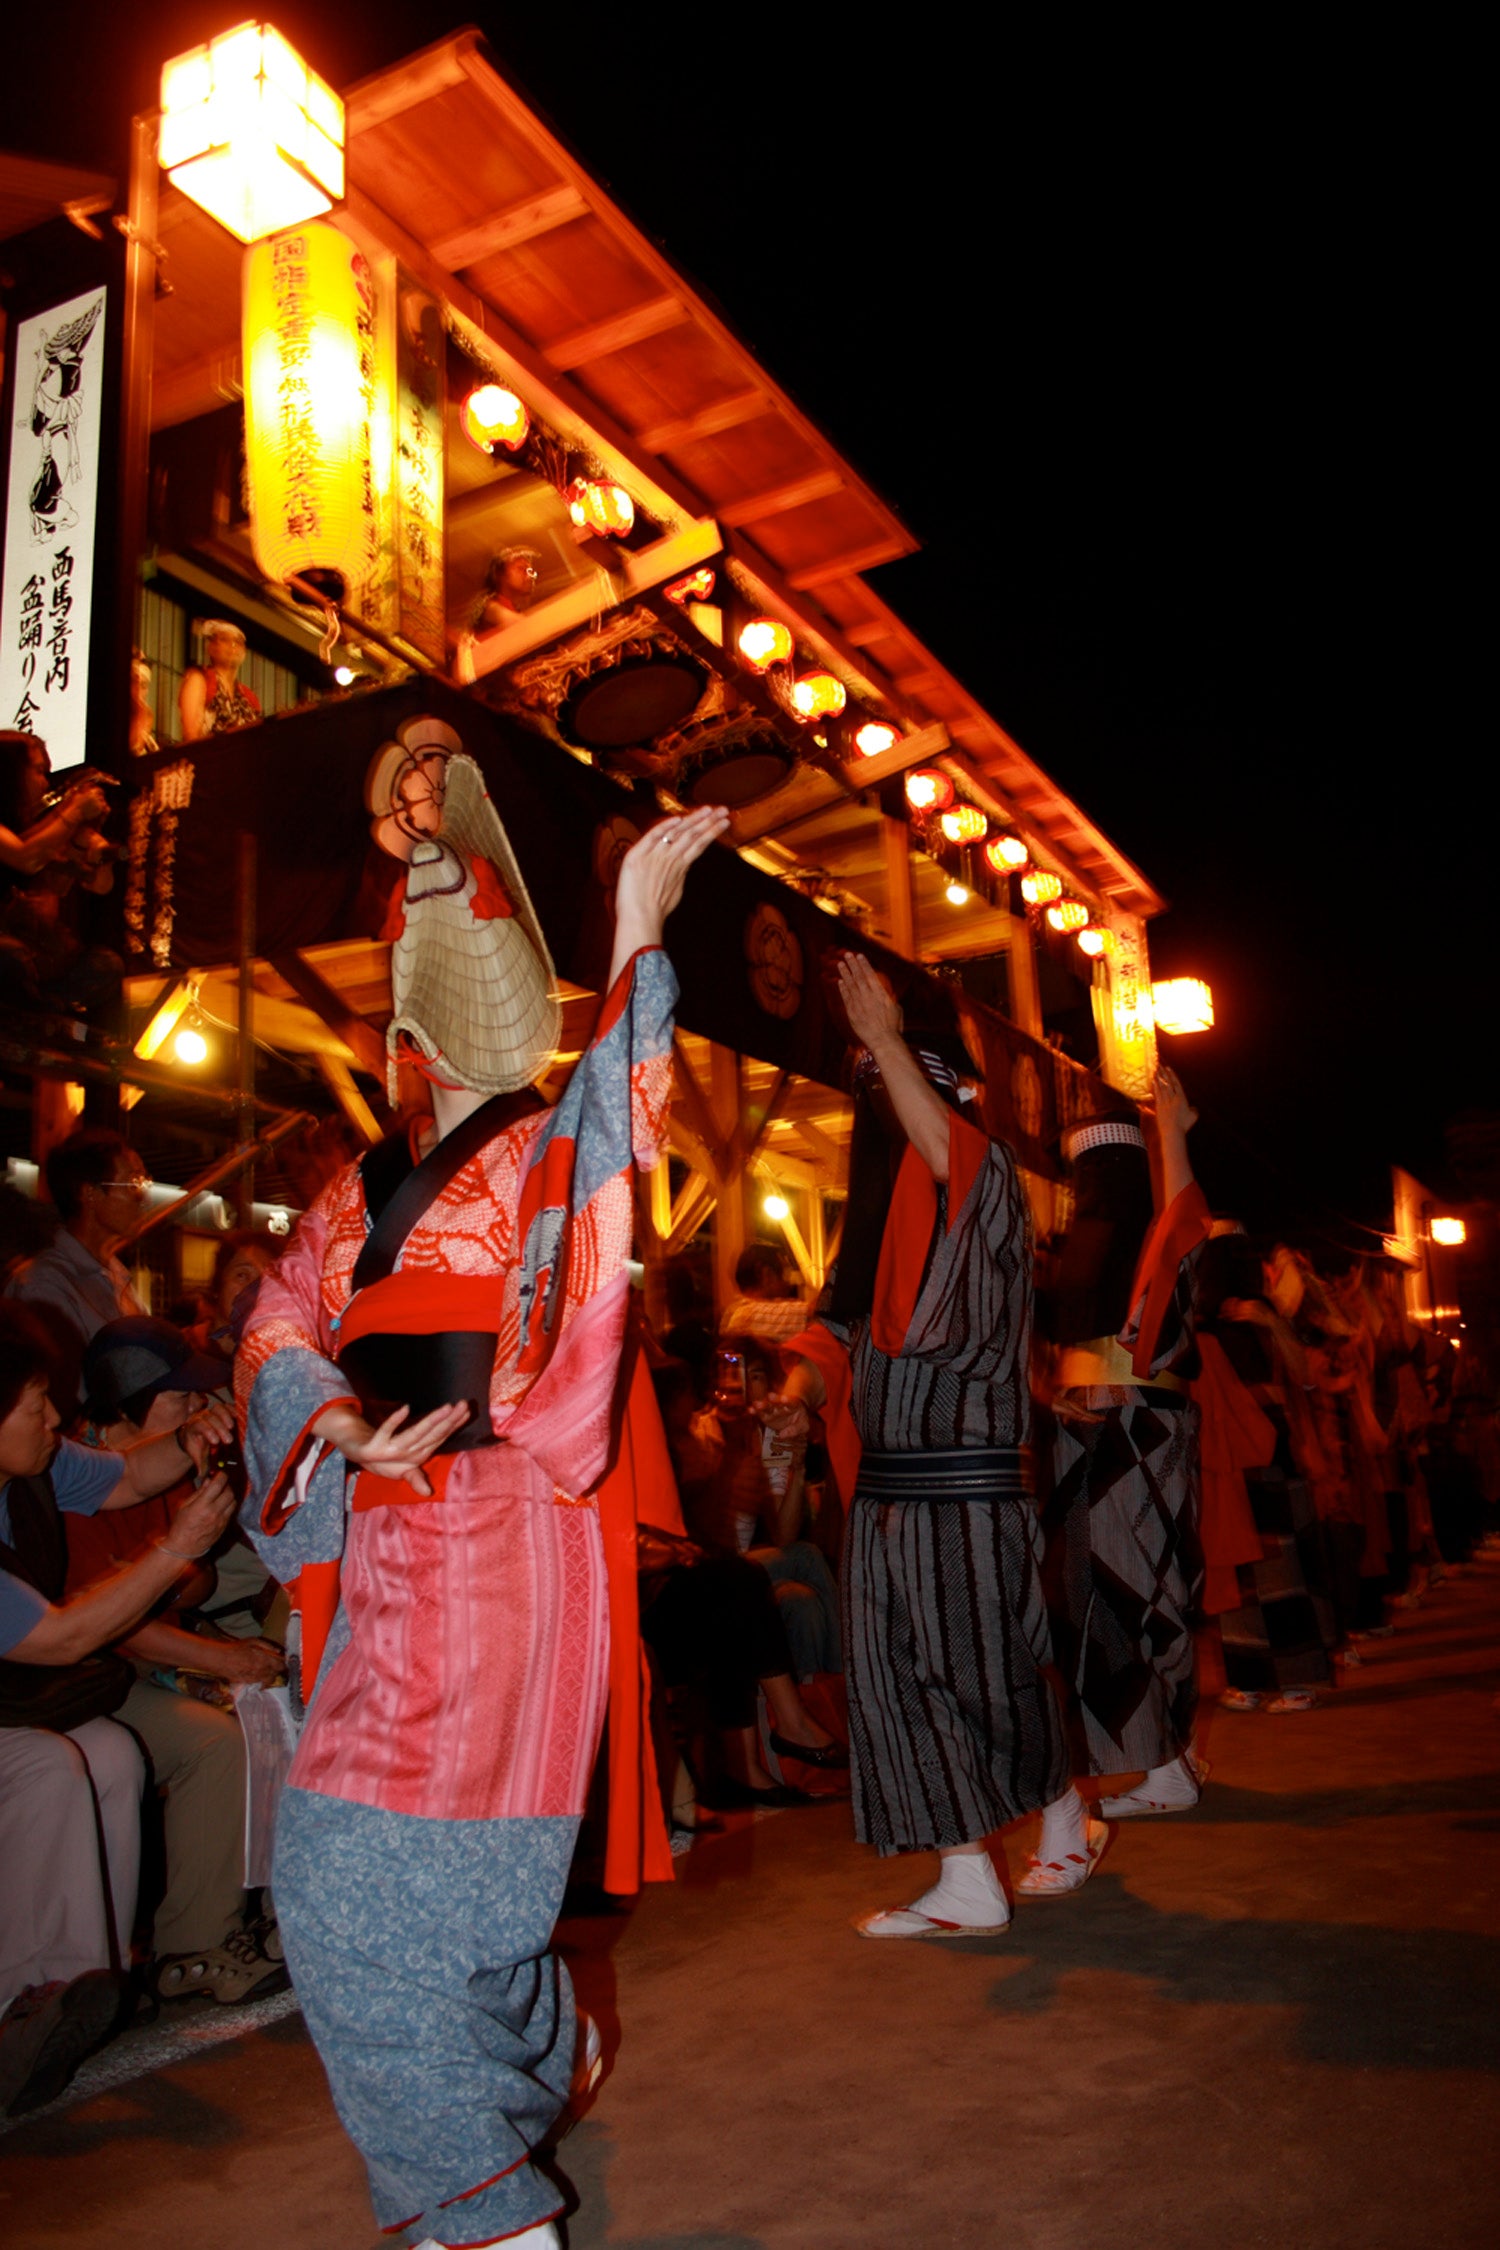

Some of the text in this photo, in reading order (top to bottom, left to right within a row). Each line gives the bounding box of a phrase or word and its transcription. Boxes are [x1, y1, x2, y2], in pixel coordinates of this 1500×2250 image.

[13, 574, 46, 736] 盆踊り会
[45, 546, 74, 693] 西馬音内
